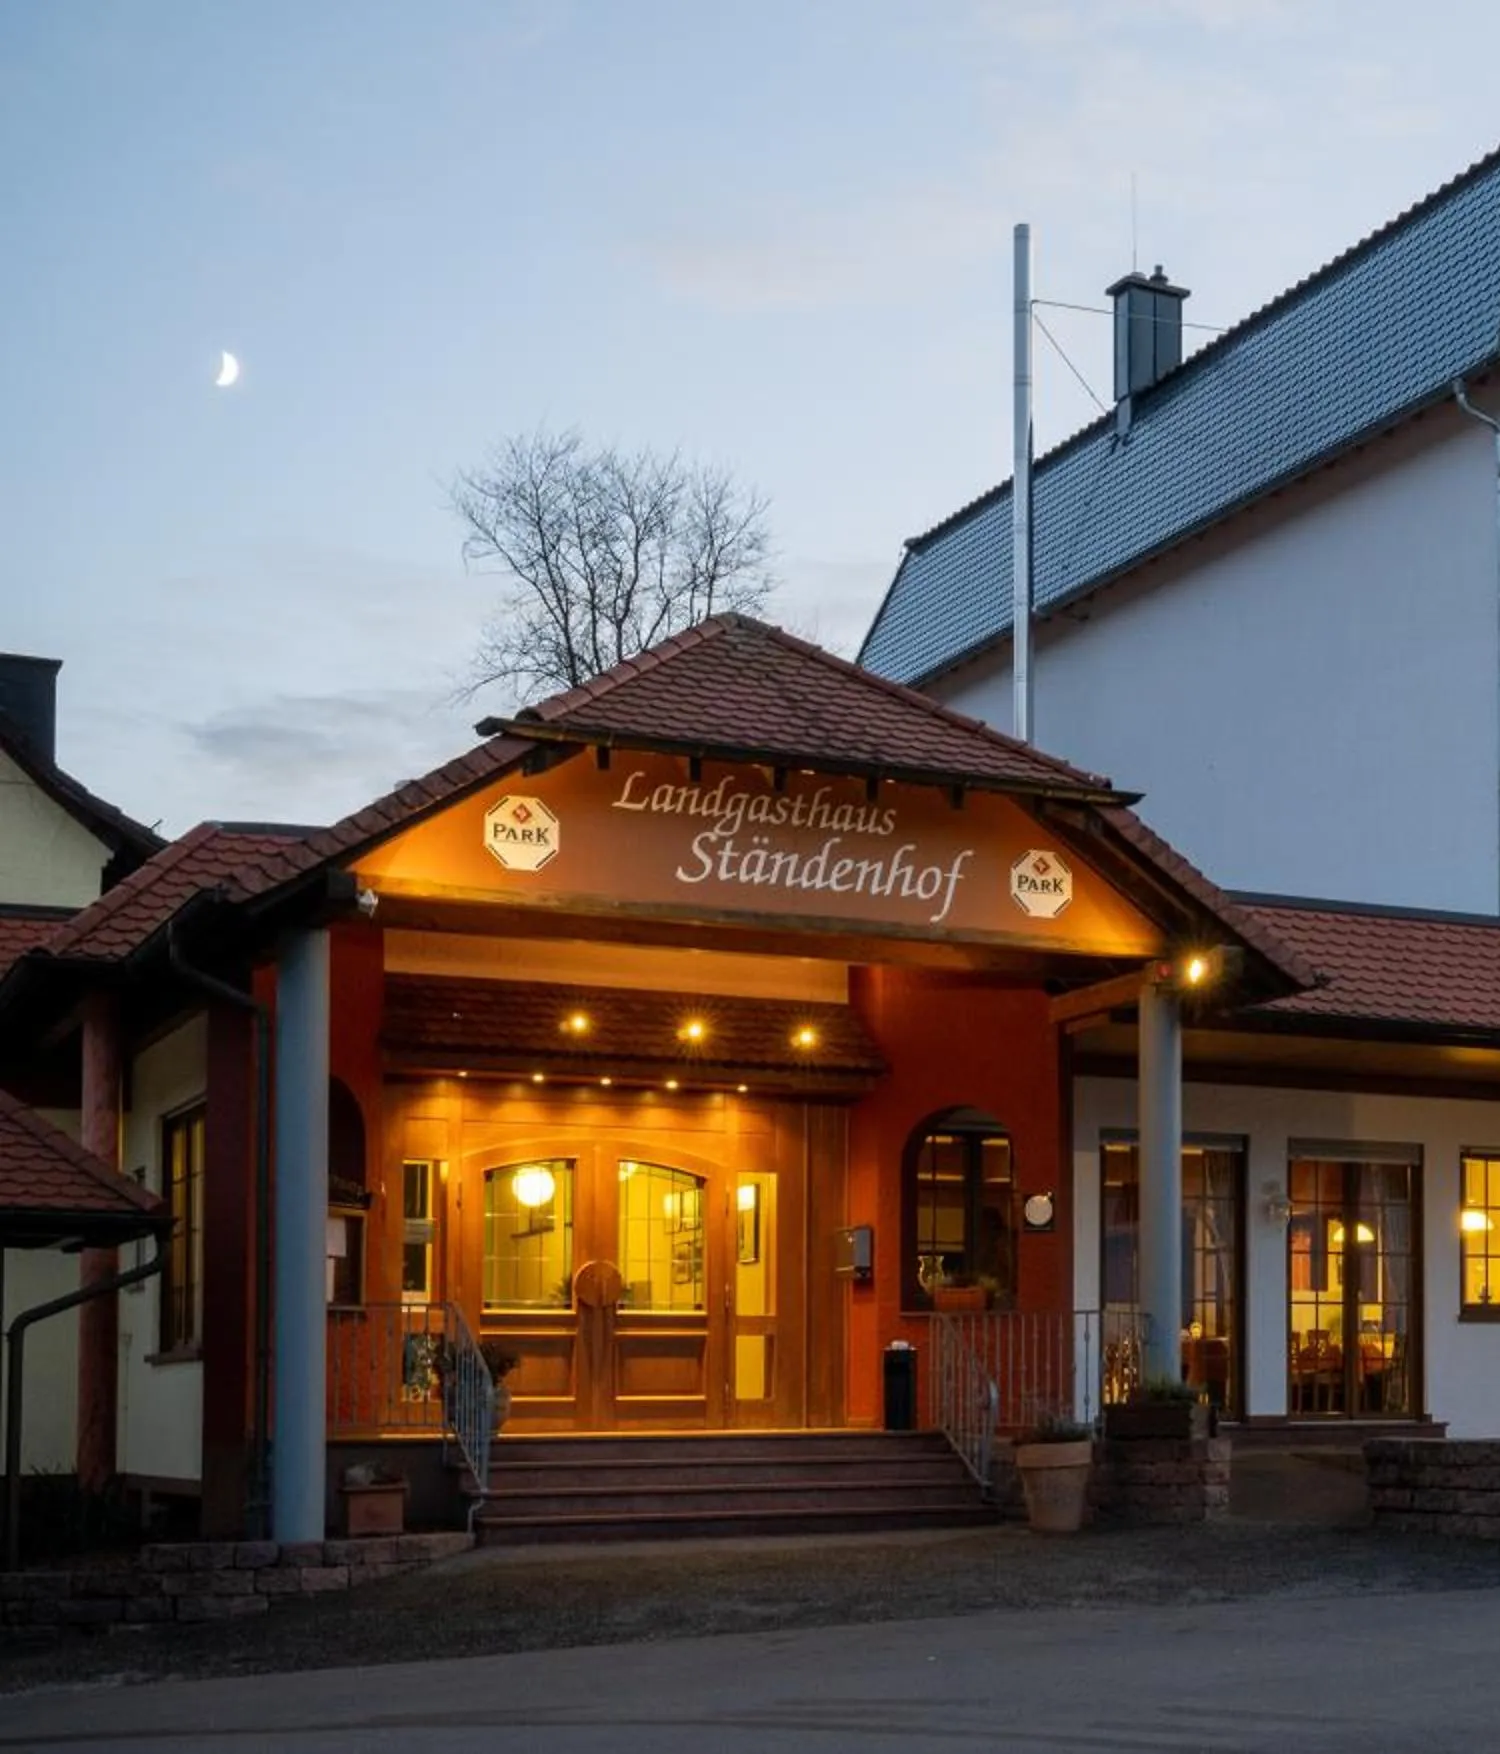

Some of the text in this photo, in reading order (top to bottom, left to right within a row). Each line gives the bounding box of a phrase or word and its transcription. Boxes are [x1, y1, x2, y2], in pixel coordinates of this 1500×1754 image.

[612, 771, 896, 836] Landgasthaus
[493, 823, 550, 845] PARK
[675, 832, 973, 923] Ständenhof
[1017, 875, 1063, 893] PARK
